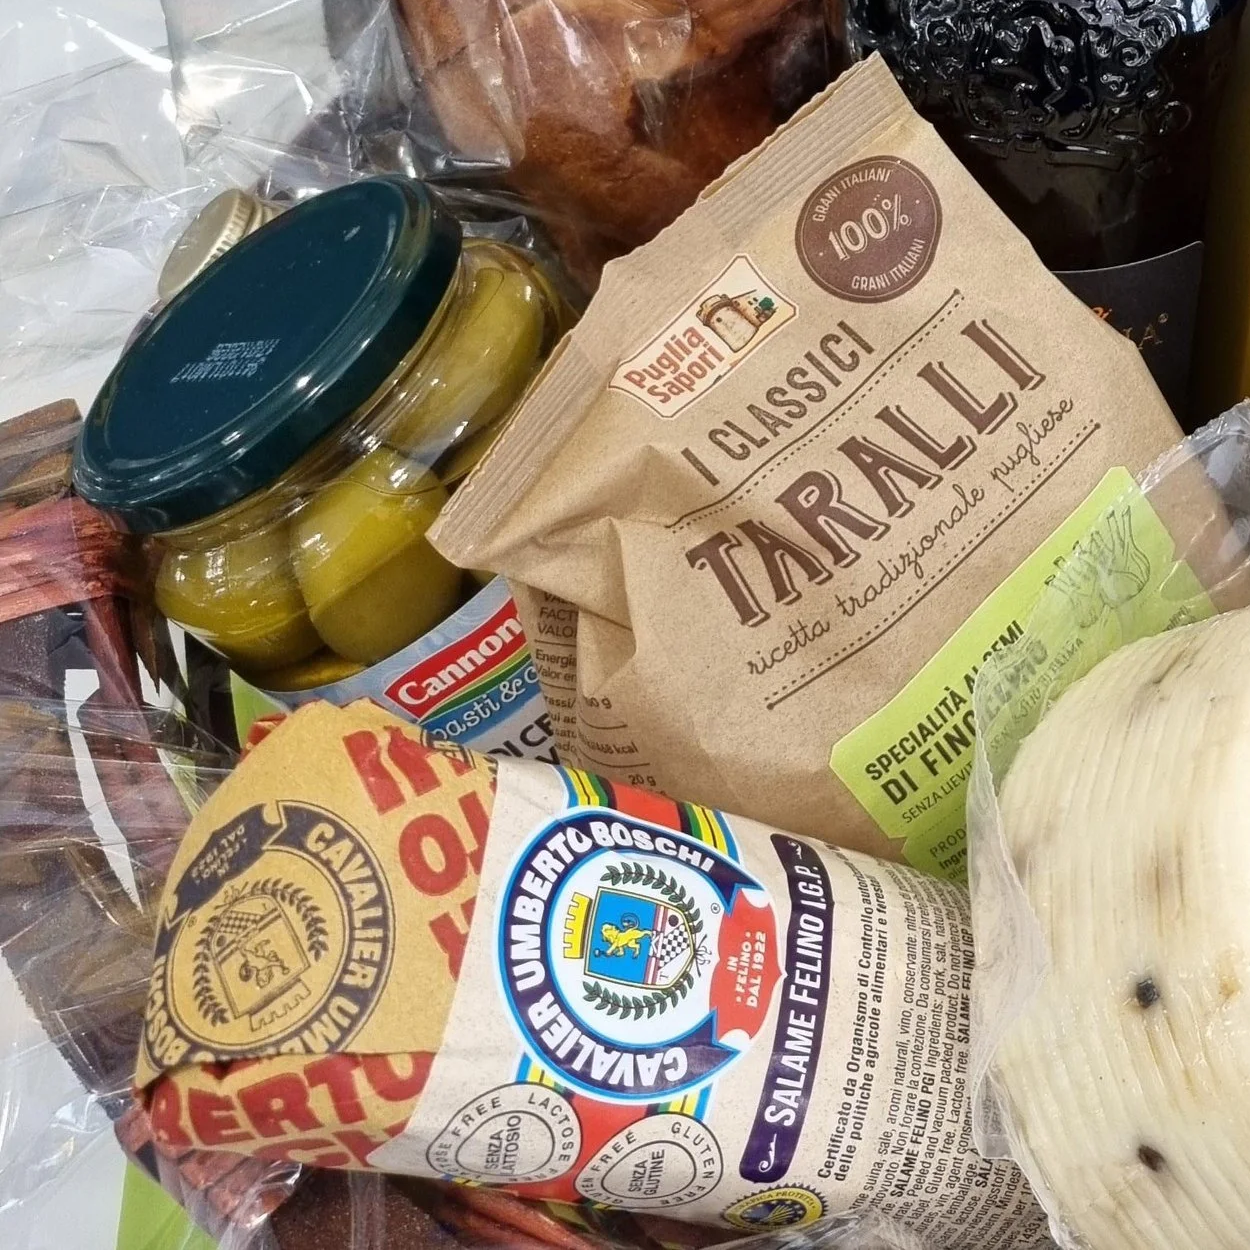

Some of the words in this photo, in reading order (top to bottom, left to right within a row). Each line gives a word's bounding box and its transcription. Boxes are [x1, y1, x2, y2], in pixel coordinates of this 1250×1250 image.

[812, 186, 841, 222] GRANI
[841, 168, 891, 190] ITALIANI
[829, 194, 912, 261] 100%
[851, 273, 891, 291] GRANI
[889, 238, 926, 282] ITALIANI
[624, 327, 706, 391] Puglia
[648, 341, 725, 405] Sapori
[681, 447, 720, 487] I
[708, 320, 876, 462] CLASSICI
[685, 319, 1046, 627] TARALLI
[747, 617, 831, 676] ricetta
[836, 482, 985, 621] tradizionale
[990, 398, 1074, 494] pugliese
[398, 616, 523, 706] Cannon
[865, 686, 967, 781] SPECIALITÀ
[880, 769, 918, 805] DI
[902, 791, 942, 824] SENZA
[589, 821, 715, 873] BOSCHI
[305, 822, 374, 988] CAVALIER
[510, 825, 593, 992] UMBERTO
[798, 867, 825, 911] I.G.P.
[750, 931, 767, 977] 1922
[789, 913, 826, 1007] FELINO
[858, 906, 874, 970] Controllo
[917, 928, 932, 991] consumarsi
[934, 941, 947, 964] salt,
[949, 922, 962, 955] pierce
[727, 956, 738, 972] IN
[736, 942, 753, 993] FELINO
[858, 972, 870, 989] di
[903, 933, 919, 1005] conservante:
[934, 967, 948, 997] pork,
[948, 973, 961, 992] Do
[746, 981, 760, 1008] DAL
[915, 991, 929, 1010] Da
[943, 992, 959, 1043] product.
[957, 991, 973, 1044] SALAME
[529, 991, 688, 1087] CAVALIER
[849, 990, 869, 1072] Organismo
[899, 1007, 915, 1036] vino,
[910, 1014, 929, 1077] confezione.
[924, 998, 943, 1071] Ingredients:
[765, 1009, 816, 1127] SALAME
[834, 1144, 857, 1181] delle
[850, 1072, 874, 1141] politiche
[863, 1007, 881, 1073] agricole
[875, 928, 888, 1004] alimentari
[894, 1038, 911, 1087] naturali,
[940, 1043, 956, 1088] packed
[845, 1075, 858, 1098] da
[886, 1089, 903, 1126] aromi
[922, 1071, 936, 1096] PGI
[950, 1077, 967, 1126] Lactose
[451, 1097, 502, 1138] FREE
[528, 1092, 572, 1163] LACTOSE
[899, 1092, 919, 1133] forare
[911, 1098, 933, 1145] FELINO
[931, 1088, 951, 1134] vacuum
[484, 1130, 504, 1171] SENZA
[500, 1115, 522, 1176] LATTOSIO
[592, 1131, 637, 1174] FREE
[672, 1121, 716, 1181] GLUTEN
[817, 1097, 853, 1179] Certificato
[878, 1128, 895, 1156] sale,
[892, 1132, 910, 1158] Non
[924, 1135, 940, 1159] and
[940, 1127, 957, 1158] free.
[628, 1161, 648, 1195] SENZA
[644, 1149, 665, 1196] GLUTINE
[864, 1161, 885, 1193] suina,
[890, 1144, 920, 1198] SALAME
[907, 1155, 933, 1198] Peeled
[924, 1157, 949, 1196] Gluten
[948, 1157, 965, 1191] agent
